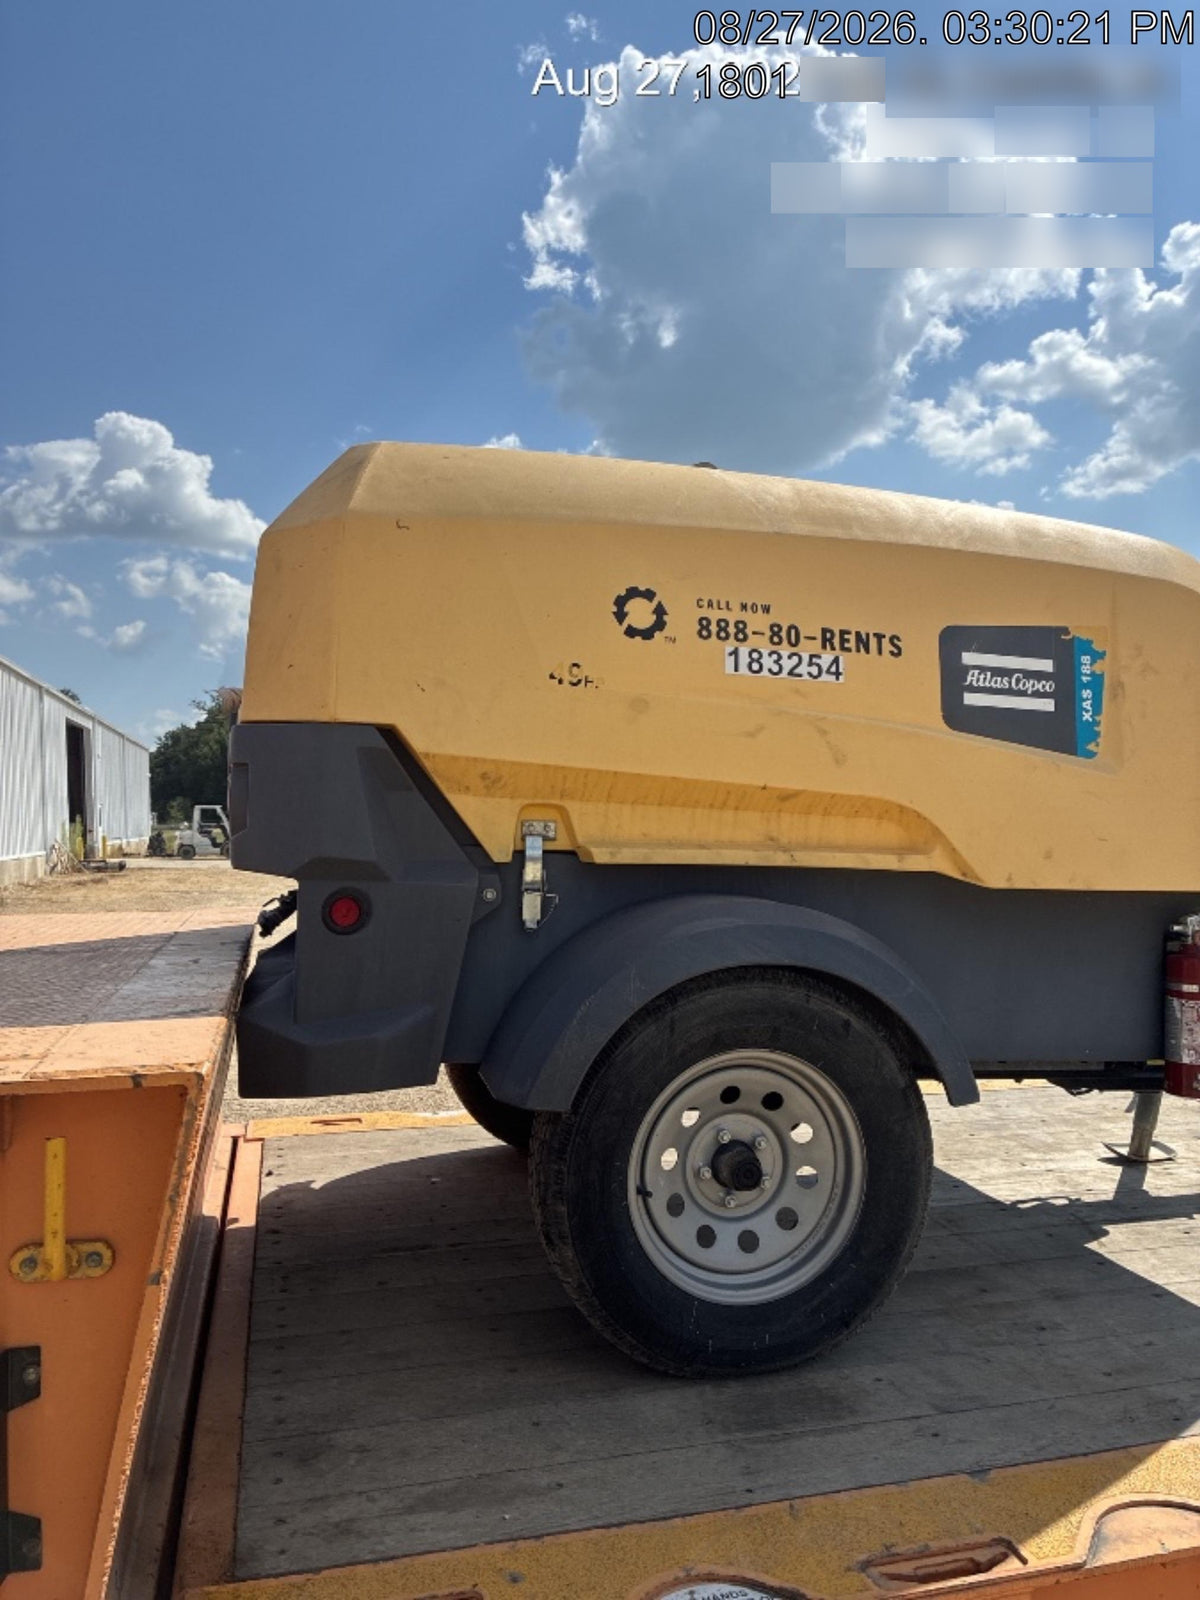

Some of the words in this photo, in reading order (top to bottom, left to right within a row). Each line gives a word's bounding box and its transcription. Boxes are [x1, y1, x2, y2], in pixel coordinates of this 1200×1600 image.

[696, 598, 732, 611] CALL
[740, 603, 771, 614] NOW
[697, 616, 903, 658] 888-80-RENTS
[727, 647, 843, 681] 183254
[1080, 655, 1092, 683] 188
[964, 669, 1010, 690] Atlas
[1011, 673, 1055, 694] Copco
[1081, 689, 1093, 722] XAS
